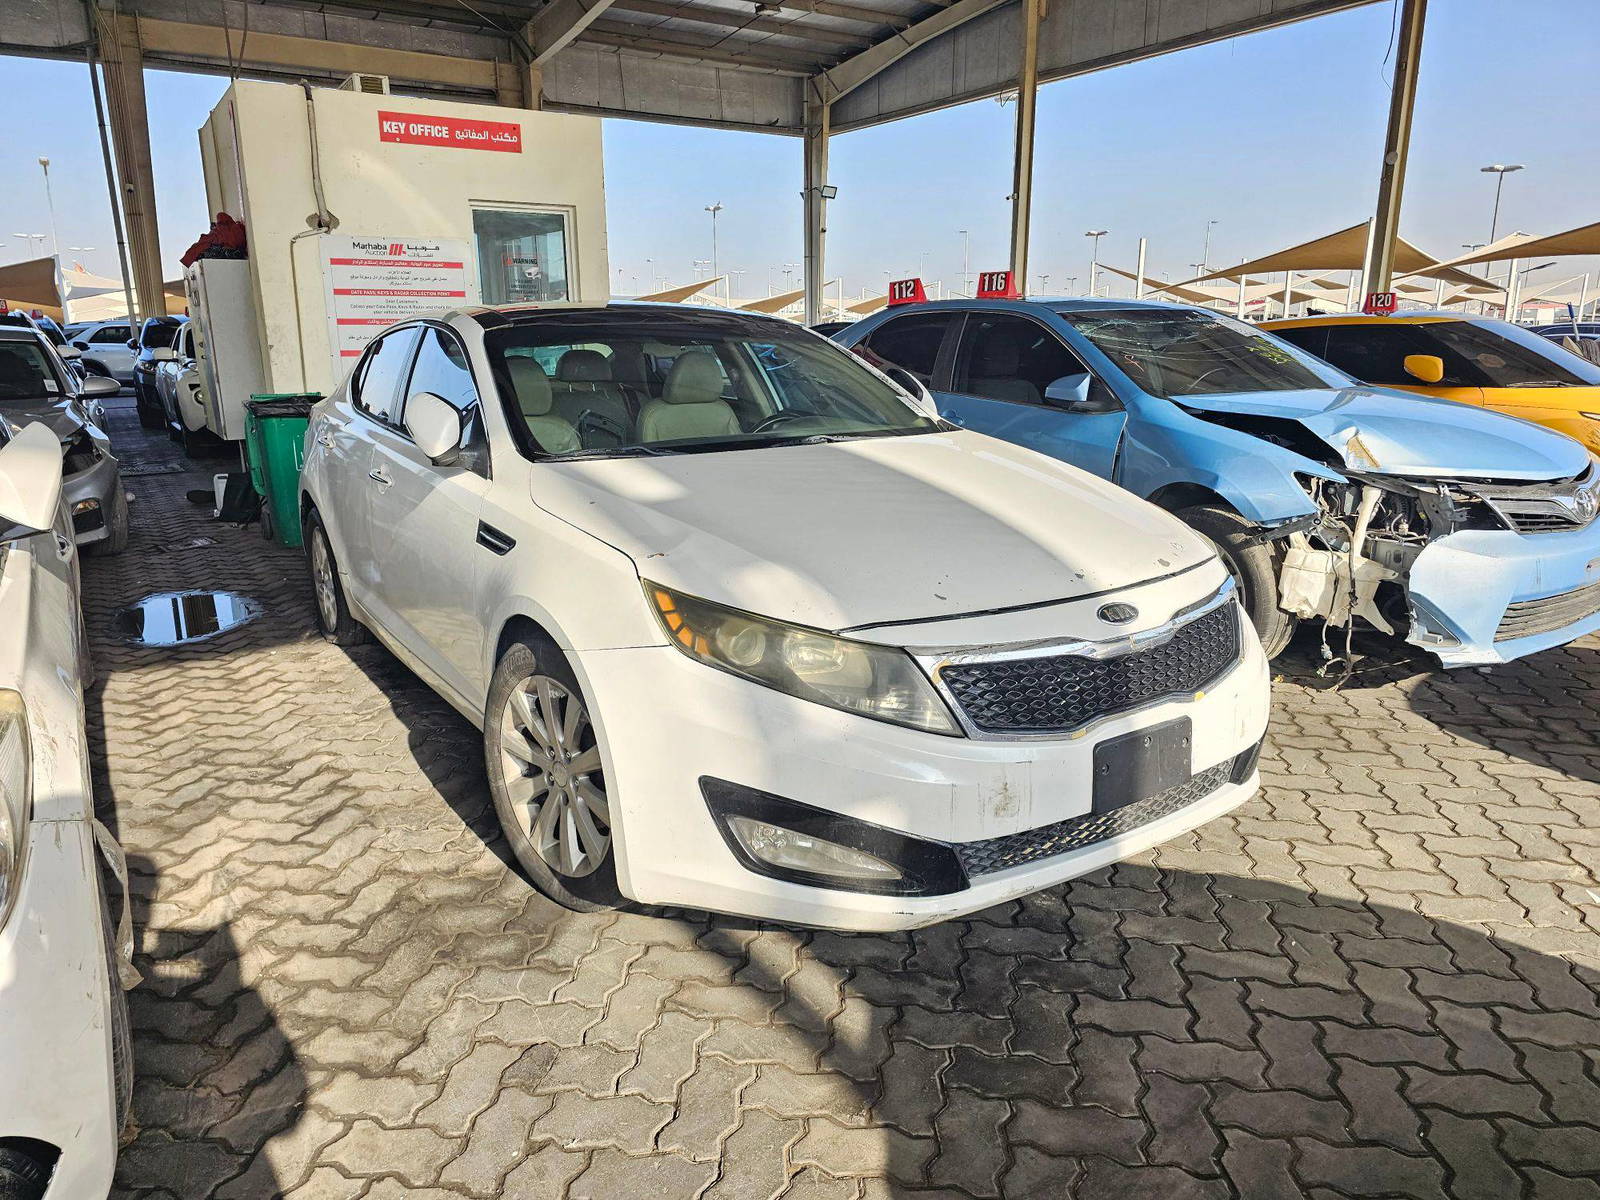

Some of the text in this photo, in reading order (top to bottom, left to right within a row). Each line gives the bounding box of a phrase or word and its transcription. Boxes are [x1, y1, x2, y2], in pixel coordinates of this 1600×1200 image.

[383, 121, 449, 138] KEY OFFICE
[455, 128, 518, 143] مكتب المفاتيح
[352, 242, 387, 251] Marhaba
[894, 281, 914, 299] 112
[984, 273, 1006, 291] 116
[1371, 294, 1392, 307] 120
